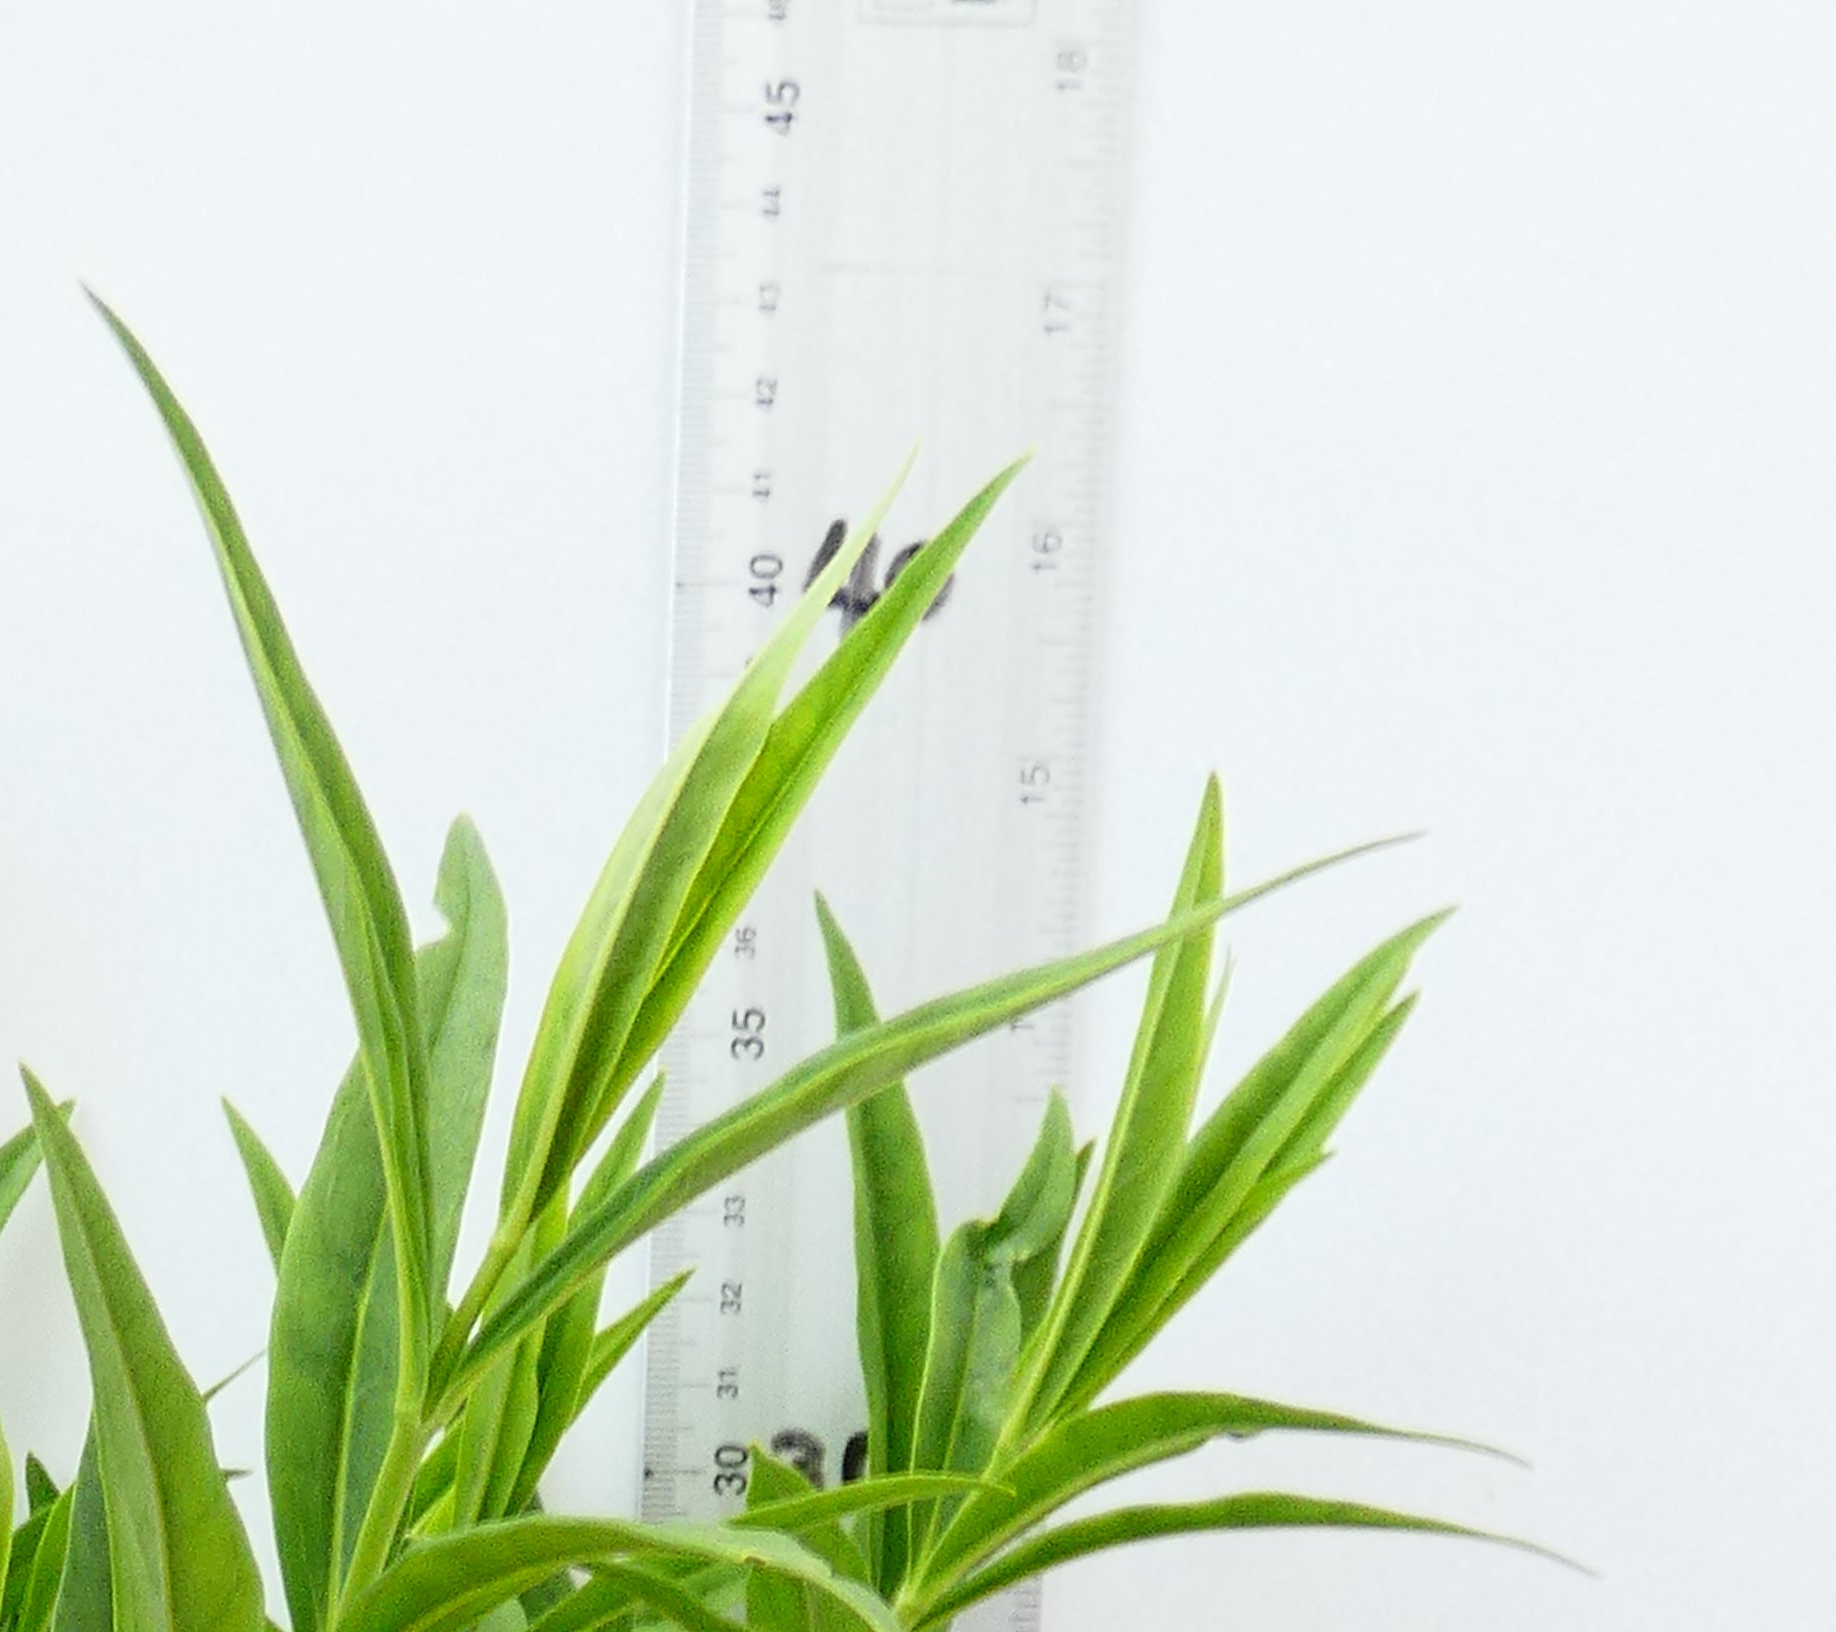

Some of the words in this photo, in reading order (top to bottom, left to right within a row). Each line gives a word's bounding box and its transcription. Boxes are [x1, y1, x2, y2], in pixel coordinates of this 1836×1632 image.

[763, 78, 801, 137] 45
[1043, 286, 1073, 336] 17
[1030, 529, 1063, 573] 16
[748, 554, 784, 608] 40
[1017, 760, 1051, 806] 15
[733, 925, 758, 961] 36
[730, 1006, 767, 1062] 35
[723, 1193, 747, 1229] 33
[720, 1281, 743, 1316] 32
[716, 1366, 740, 1400] 31
[713, 1444, 749, 1496] 30
